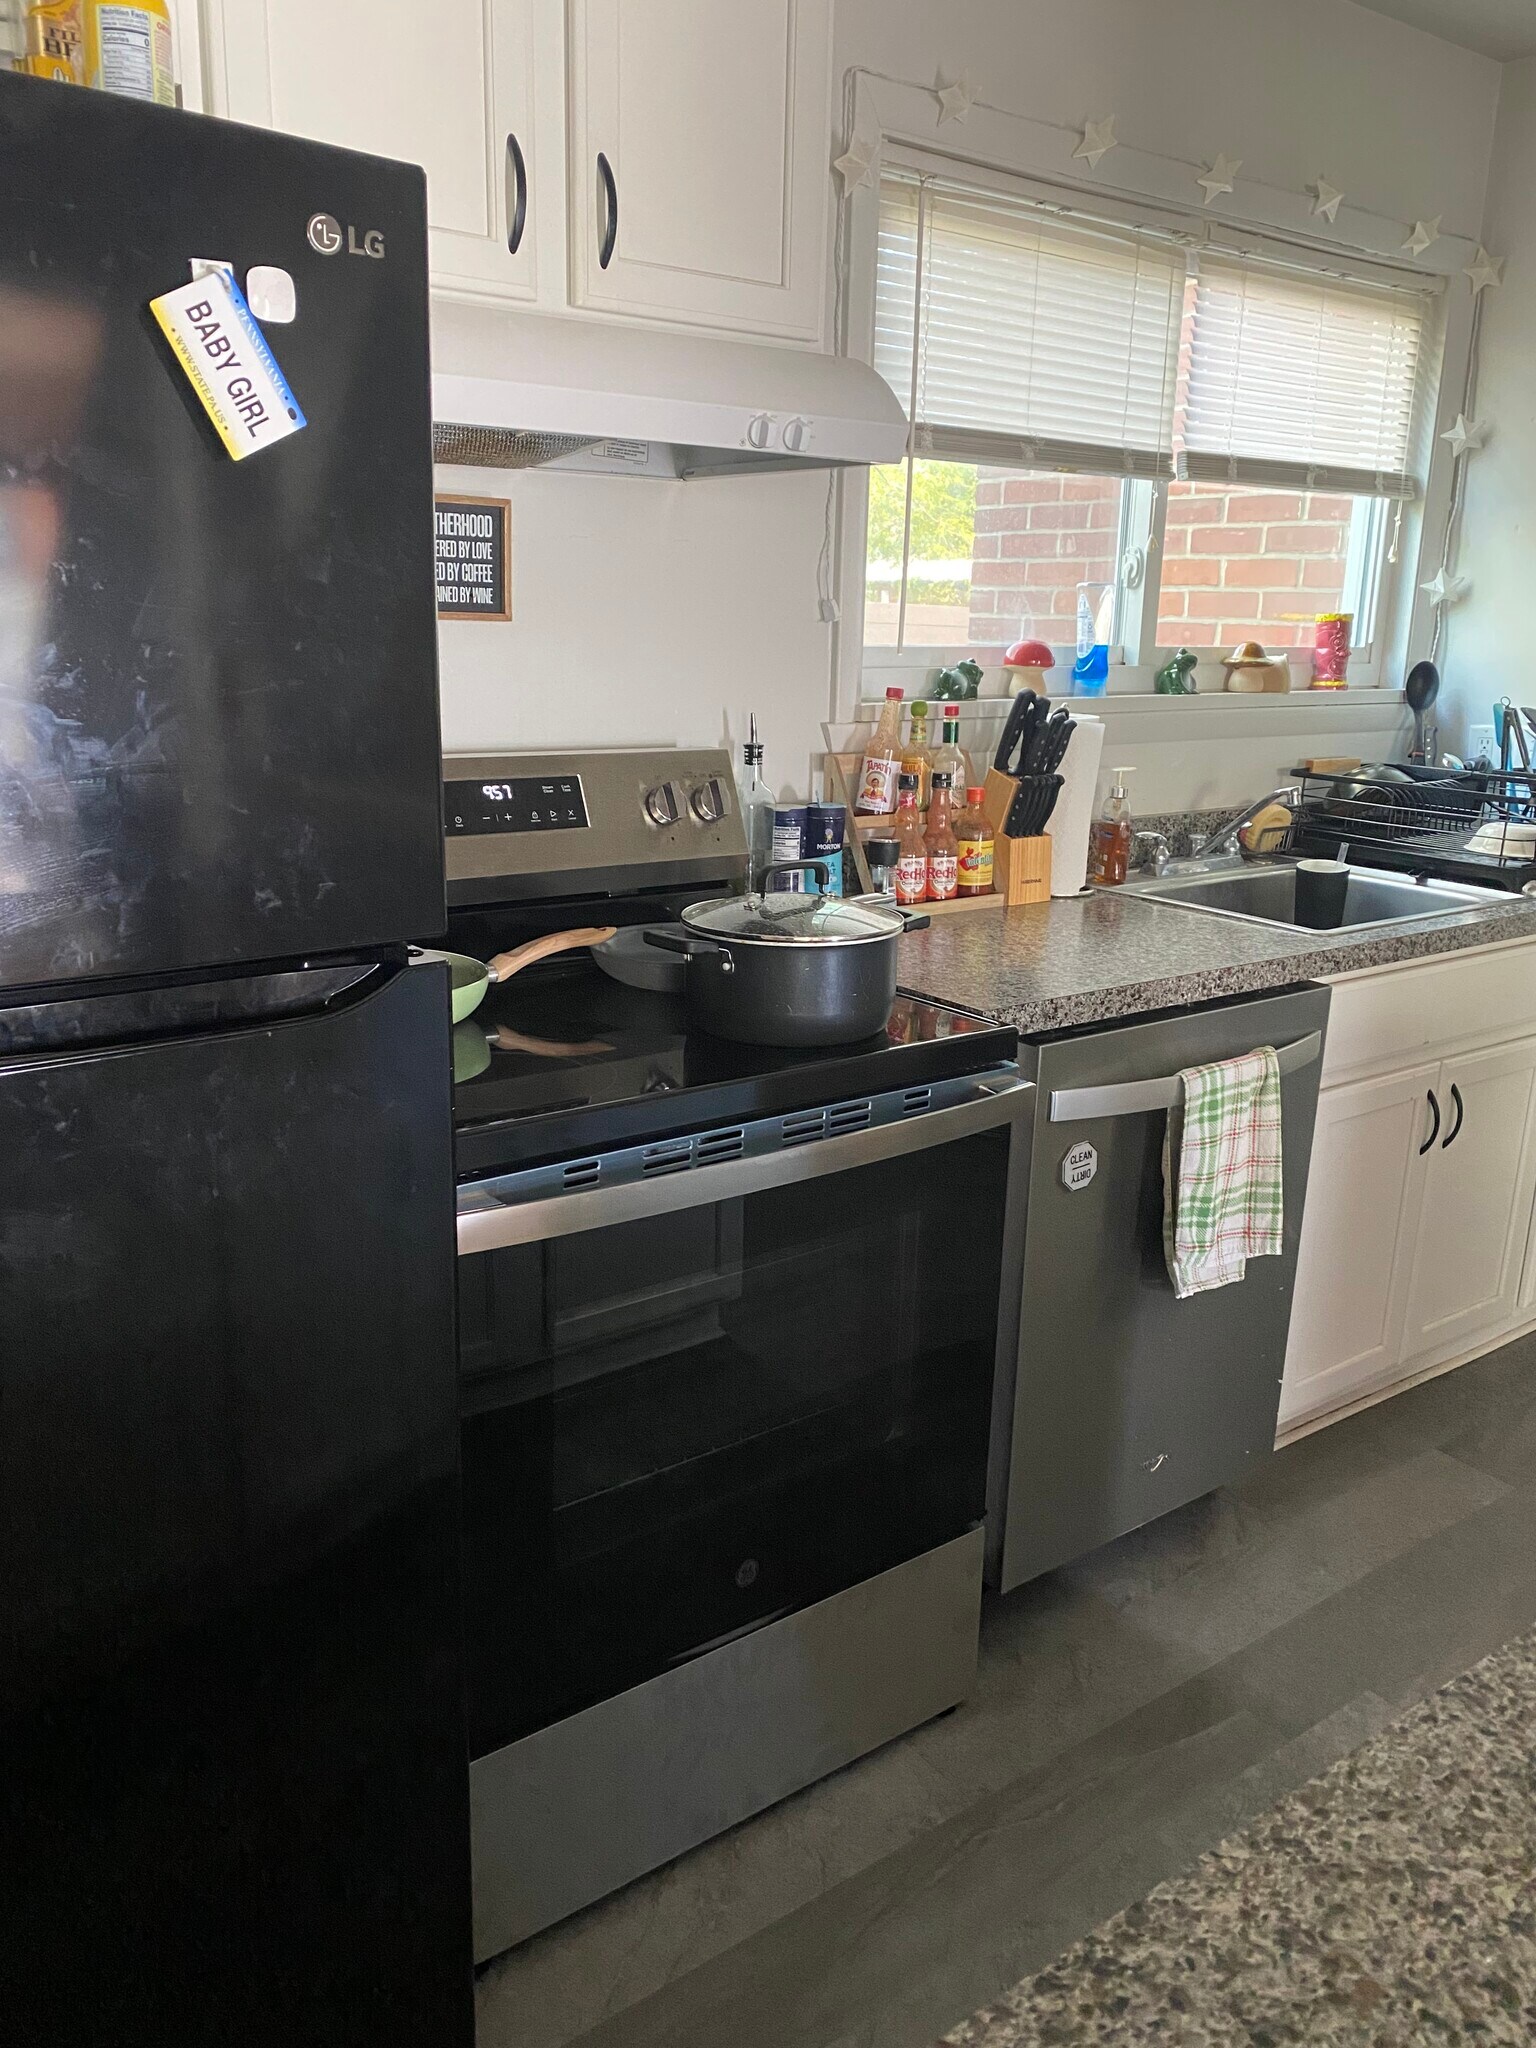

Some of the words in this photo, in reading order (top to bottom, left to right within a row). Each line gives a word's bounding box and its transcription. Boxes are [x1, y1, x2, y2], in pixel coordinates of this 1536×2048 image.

[347, 225, 385, 258] LG
[236, 308, 286, 396] PENNSYLVANIA
[184, 299, 242, 371] BABY
[226, 377, 270, 438] GIRL
[458, 540, 471, 559] BY
[472, 541, 493, 560] LOVE
[447, 562, 460, 582] BY
[461, 562, 493, 583] COFFEE
[459, 586, 472, 604] BY
[471, 587, 494, 604] WINE
[1070, 1149, 1093, 1165] CLEAN
[1070, 1168, 1092, 1184] DIRTY
